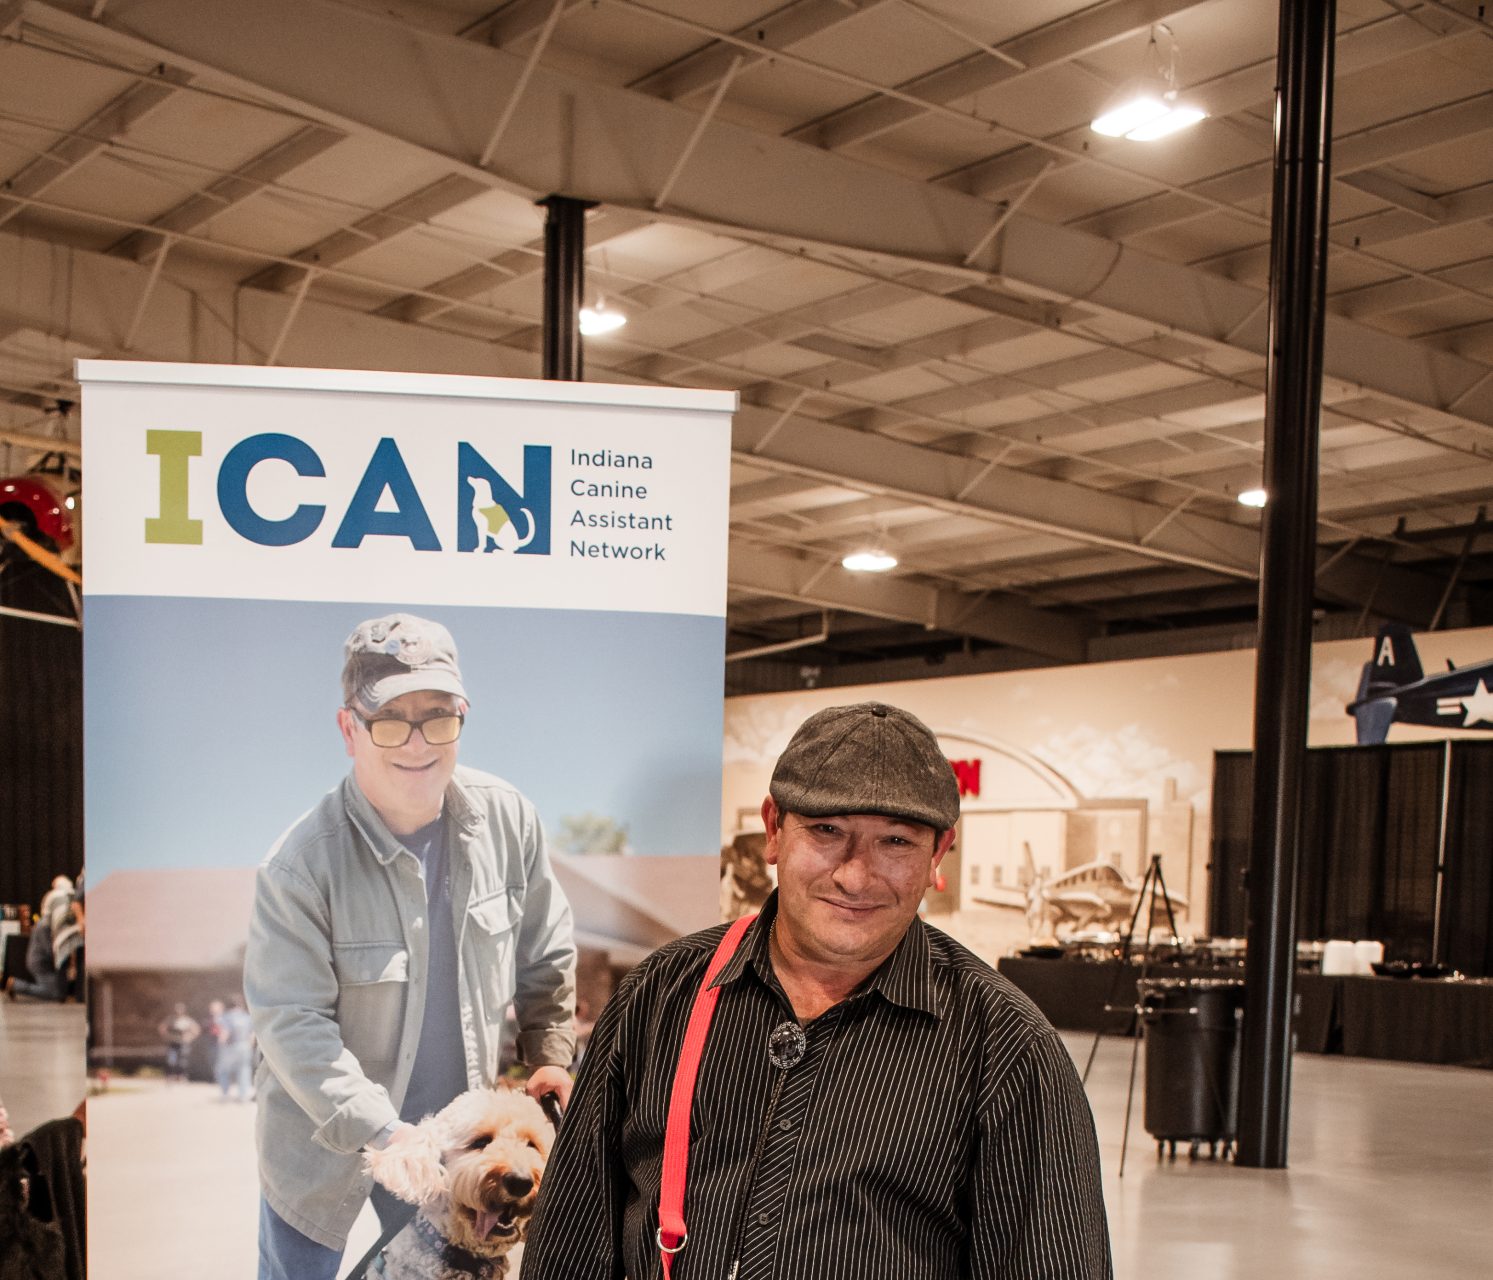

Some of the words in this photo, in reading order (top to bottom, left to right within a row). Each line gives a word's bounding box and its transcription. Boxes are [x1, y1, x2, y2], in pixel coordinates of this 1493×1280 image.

[571, 448, 653, 470] Indiana
[145, 429, 552, 556] ICAN
[570, 478, 648, 500] Canine
[570, 509, 673, 531] Assistant
[570, 539, 666, 561] Network
[1377, 636, 1396, 667] A
